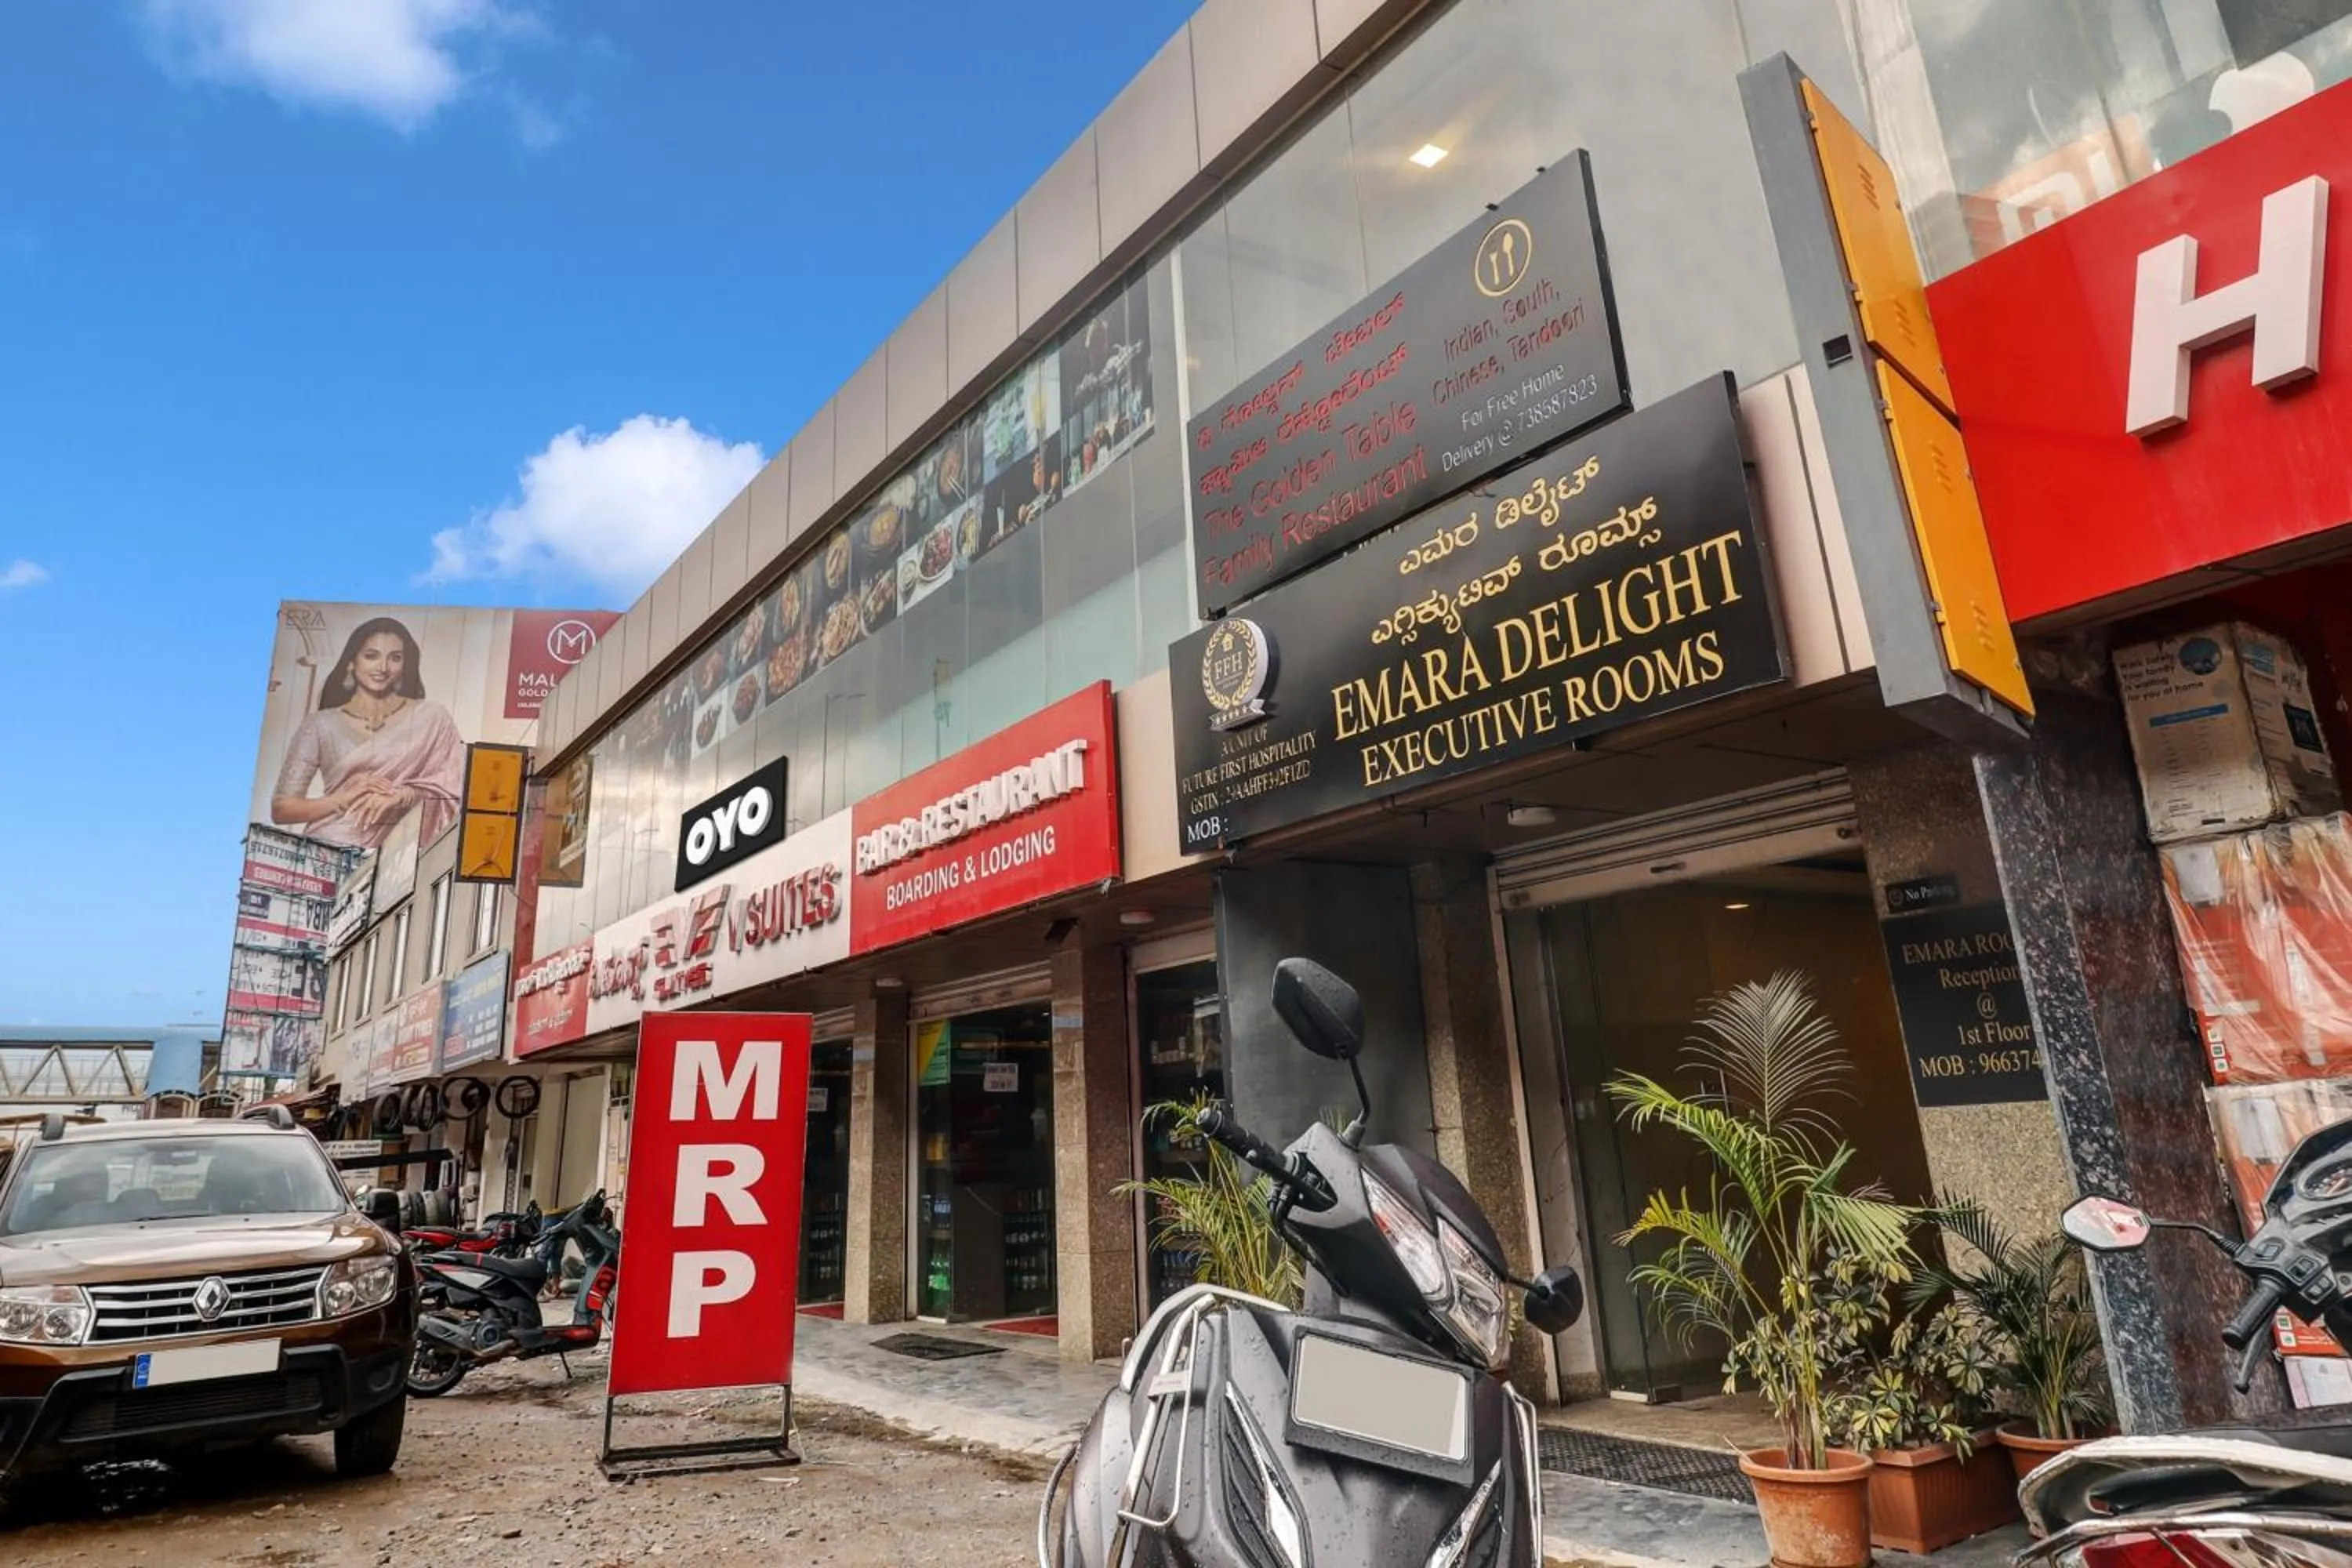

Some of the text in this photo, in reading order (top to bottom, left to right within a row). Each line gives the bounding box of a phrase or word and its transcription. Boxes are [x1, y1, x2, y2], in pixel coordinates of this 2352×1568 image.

[1444, 278, 1561, 361] Indian, South,
[2126, 173, 2328, 438] H
[1432, 298, 1586, 408] Chinese, Tandoori
[1461, 363, 1566, 432] For Free Home
[1203, 400, 1417, 542] The Golden Table
[1442, 434, 1494, 473] Delivery
[1498, 419, 1515, 446] @
[1203, 443, 1430, 585] Family Restaurant
[1399, 512, 1480, 575] ಎಮರ
[1215, 652, 1243, 681] FFH
[1332, 528, 1744, 742] EMARA DELIGHT
[518, 673, 555, 687] MAL
[1362, 630, 1726, 787] EXECUTIVE ROOMS
[1181, 729, 1318, 795] FUTURE FIRST HOSPITALITY
[1254, 723, 1268, 743] OF
[686, 786, 772, 865] OYO
[855, 825, 899, 876] BAR
[922, 739, 1087, 851] RESTAURANT
[1188, 816, 1221, 843] MOB
[887, 826, 1055, 910] BOARDING & LODGING
[746, 862, 843, 946] SUITES
[1902, 931, 2018, 964] EMARA ROO
[1938, 960, 2024, 990] Reception
[1958, 1022, 2031, 1045] 1st Floor
[1976, 991, 1998, 1019] @
[1919, 1055, 1965, 1078] MOB
[1978, 1050, 2043, 1074] 966374
